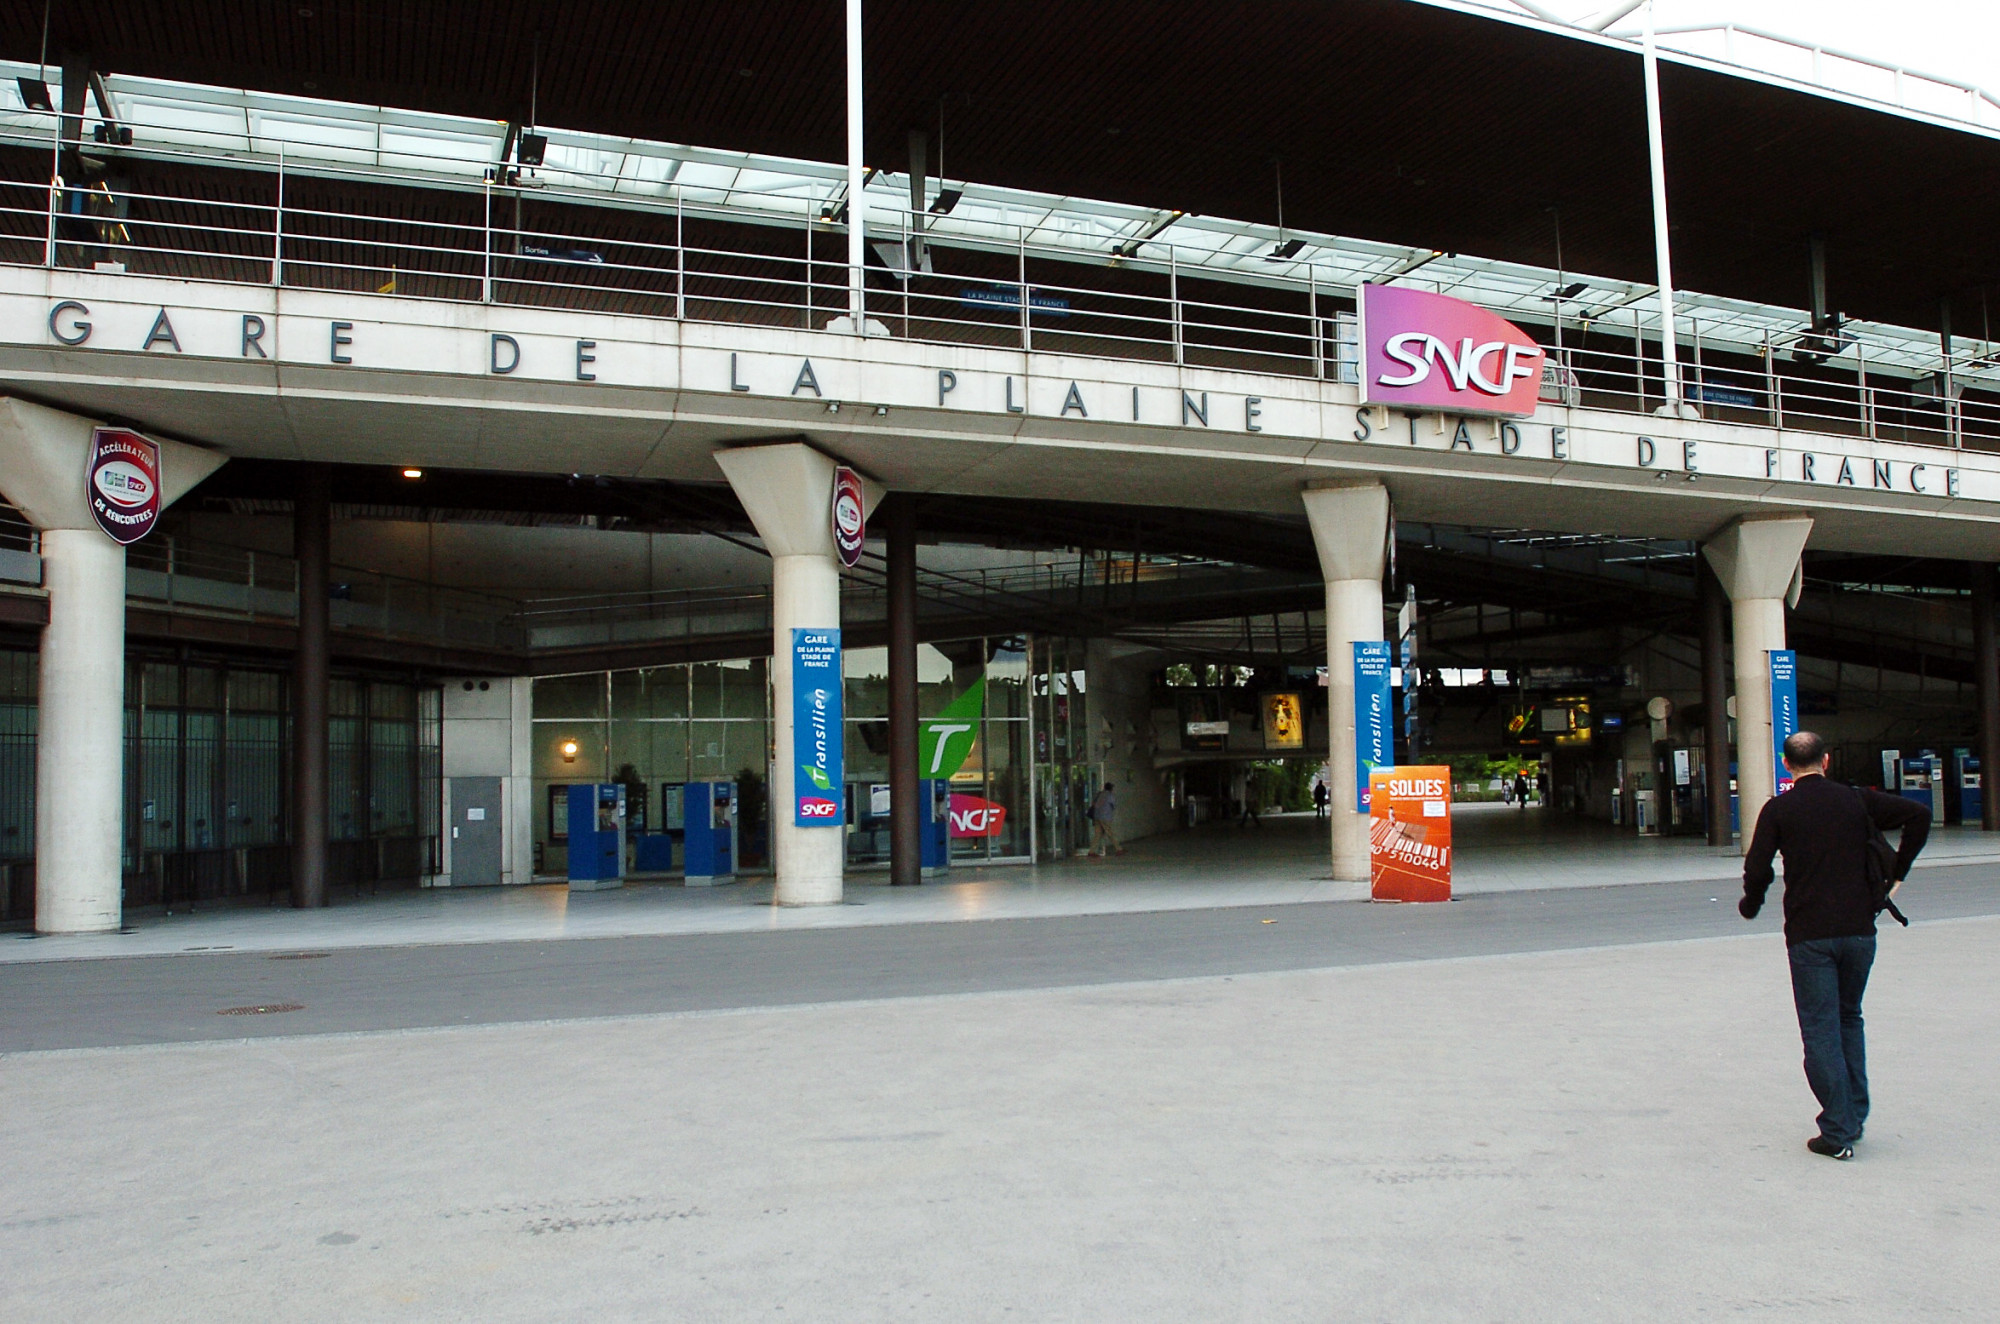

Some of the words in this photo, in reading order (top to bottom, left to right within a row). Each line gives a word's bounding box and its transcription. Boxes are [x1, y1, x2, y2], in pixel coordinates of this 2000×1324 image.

[1378, 331, 1541, 395] SNCF
[50, 300, 353, 365] GARE
[490, 333, 597, 382] DE
[730, 352, 822, 397] LA
[938, 369, 1263, 432] PLAINE
[1353, 407, 1569, 460] STADE
[1638, 435, 1698, 473] DE
[1765, 448, 1961, 497] FRANCE
[94, 498, 106, 513] DE
[105, 508, 154, 525] RENCONTRES
[804, 635, 828, 644] GARE
[812, 688, 826, 782] Transilien
[928, 724, 971, 774] T
[801, 803, 836, 816] SNCF
[949, 809, 1001, 832] NCF
[1388, 849, 1440, 870] 510046
